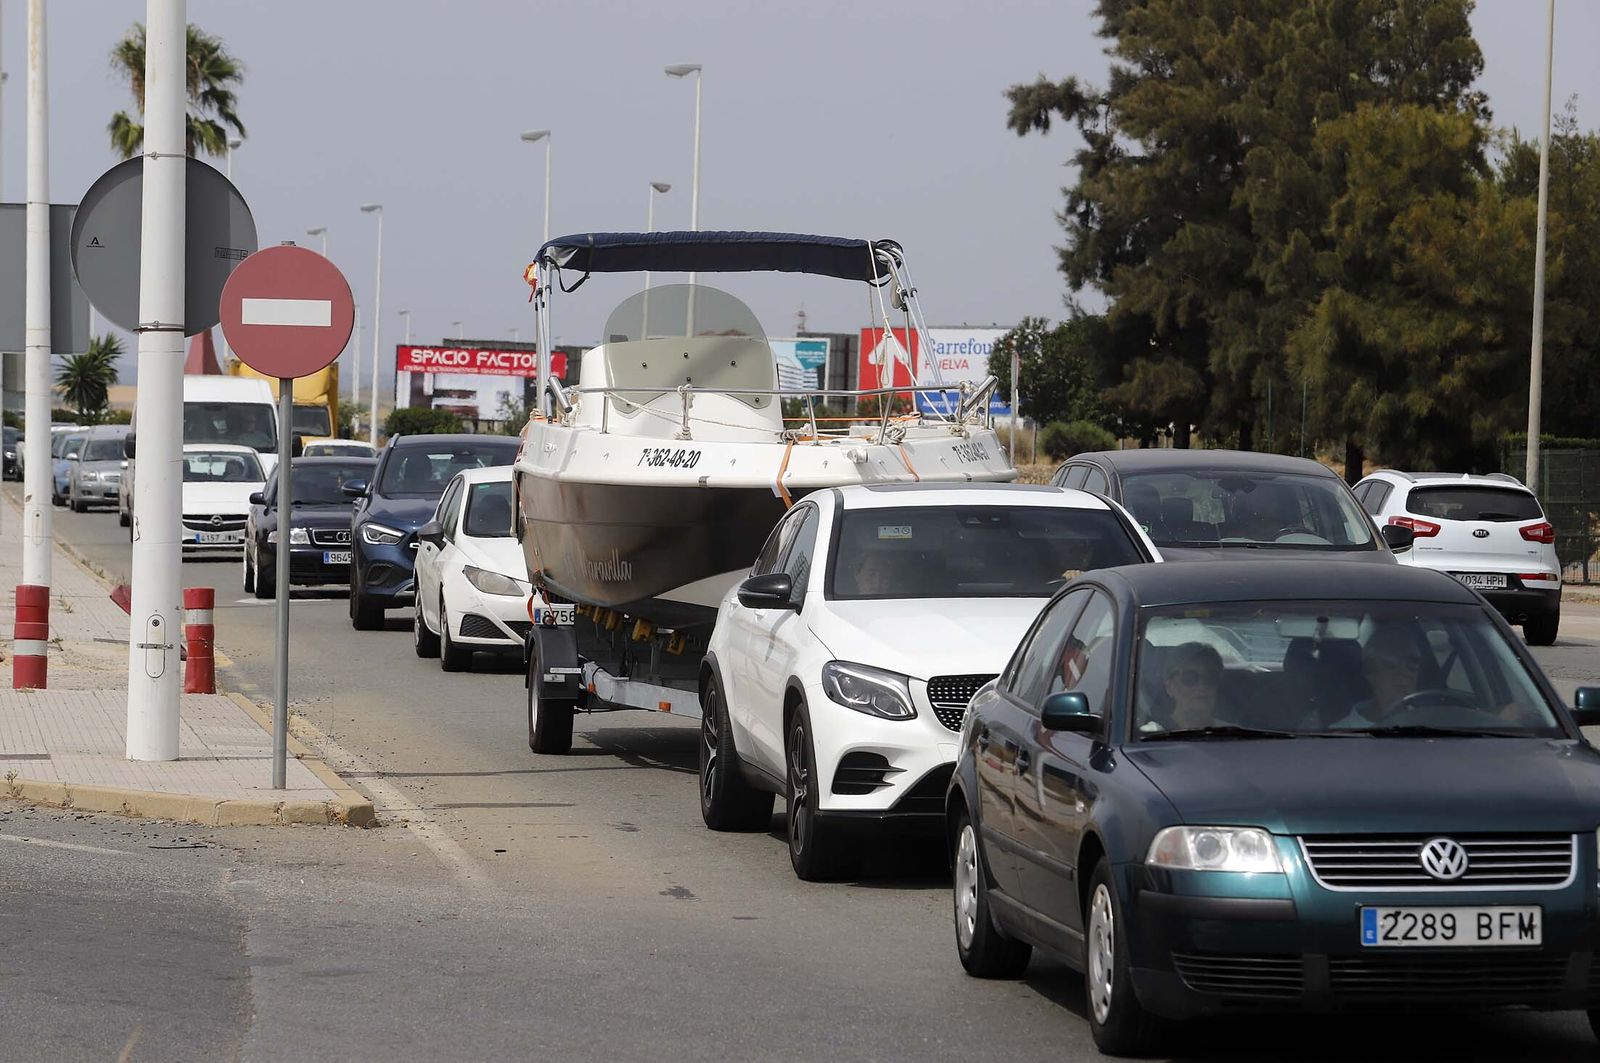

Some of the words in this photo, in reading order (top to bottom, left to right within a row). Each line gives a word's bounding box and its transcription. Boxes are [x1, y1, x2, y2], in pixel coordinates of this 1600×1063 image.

[410, 349, 470, 365] SPACIO
[1486, 576, 1504, 586] HPH
[1382, 911, 1456, 941] 2289
[1477, 912, 1535, 940] BFM
